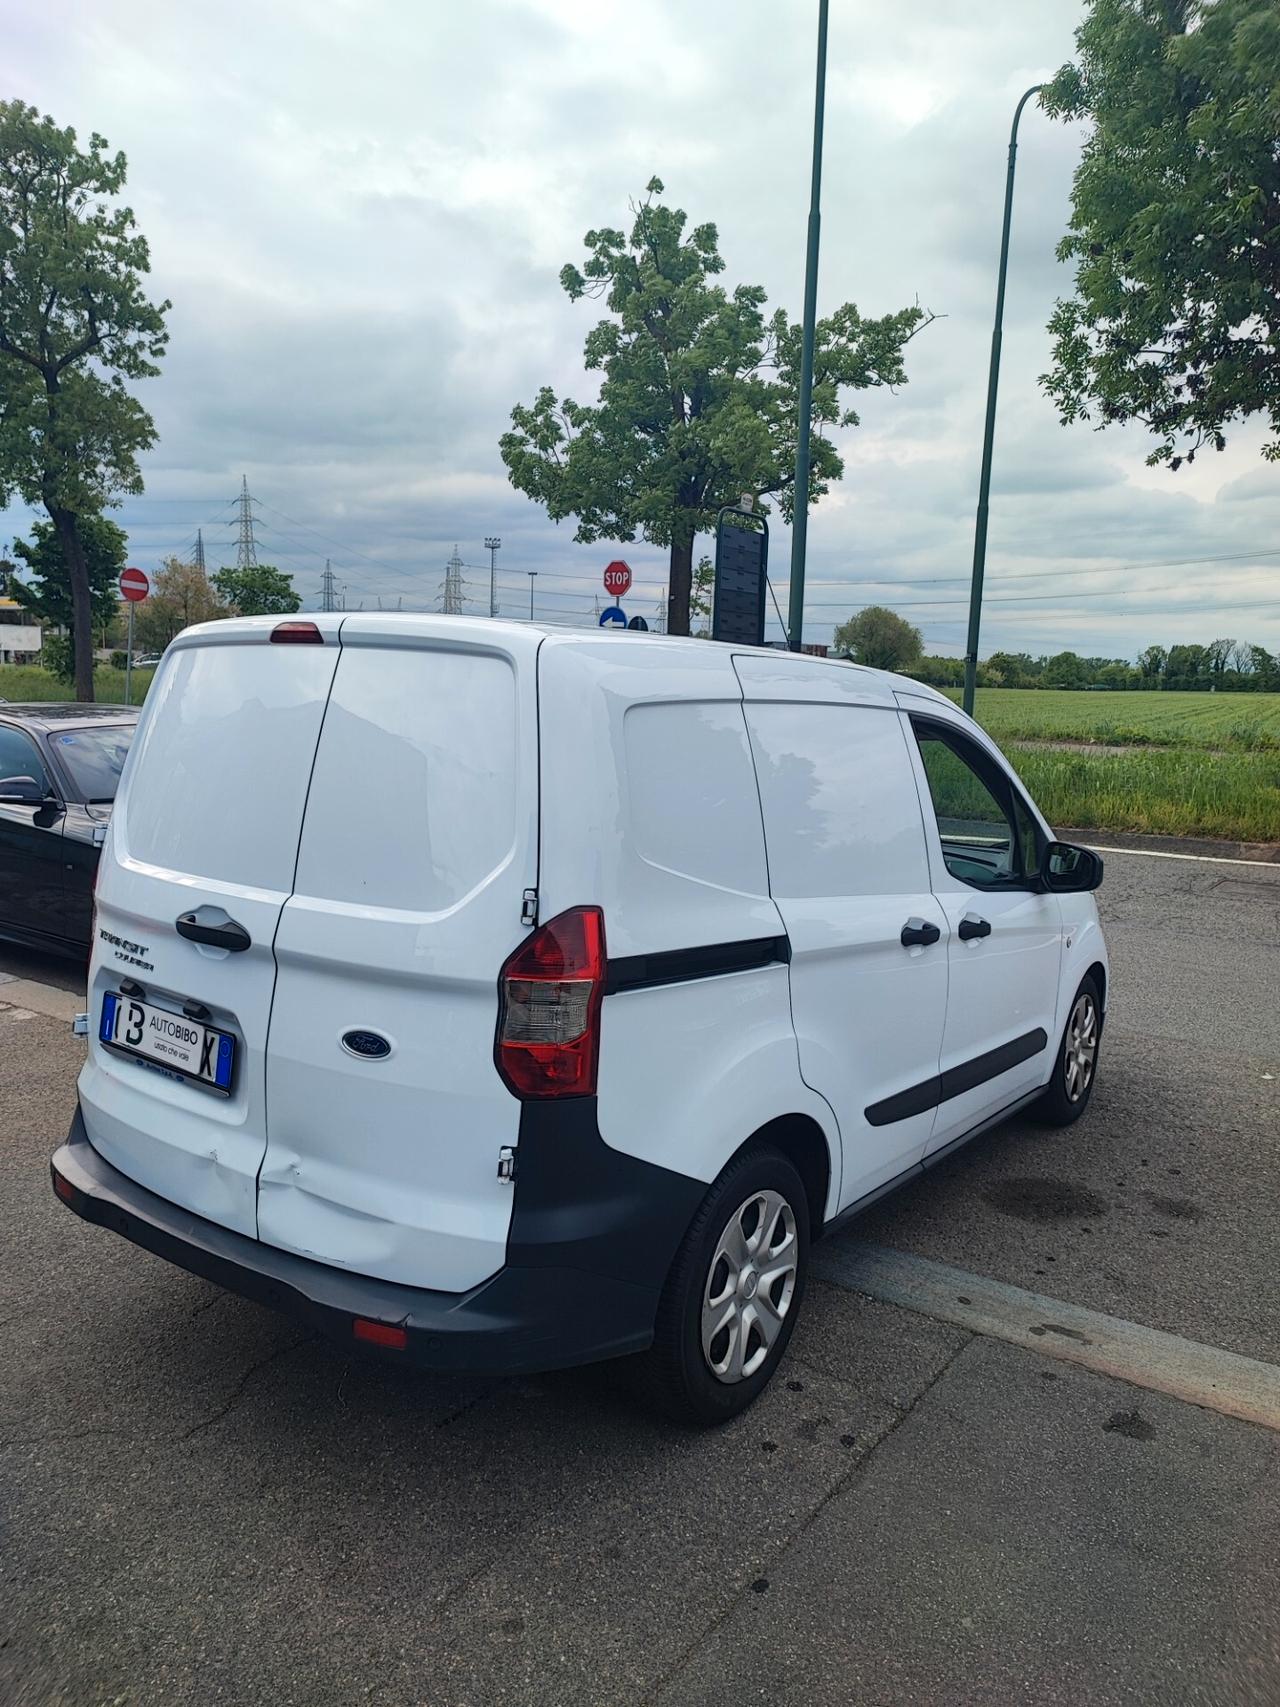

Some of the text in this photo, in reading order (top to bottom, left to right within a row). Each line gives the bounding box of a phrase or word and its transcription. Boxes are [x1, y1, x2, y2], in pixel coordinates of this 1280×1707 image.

[605, 572, 629, 585] STOP
[100, 928, 149, 956] TRANSIT
[150, 1016, 198, 1045] AUTOBIBO
[353, 1034, 380, 1052] Ford
[168, 1046, 178, 1057] che
[178, 1051, 189, 1062] vale
